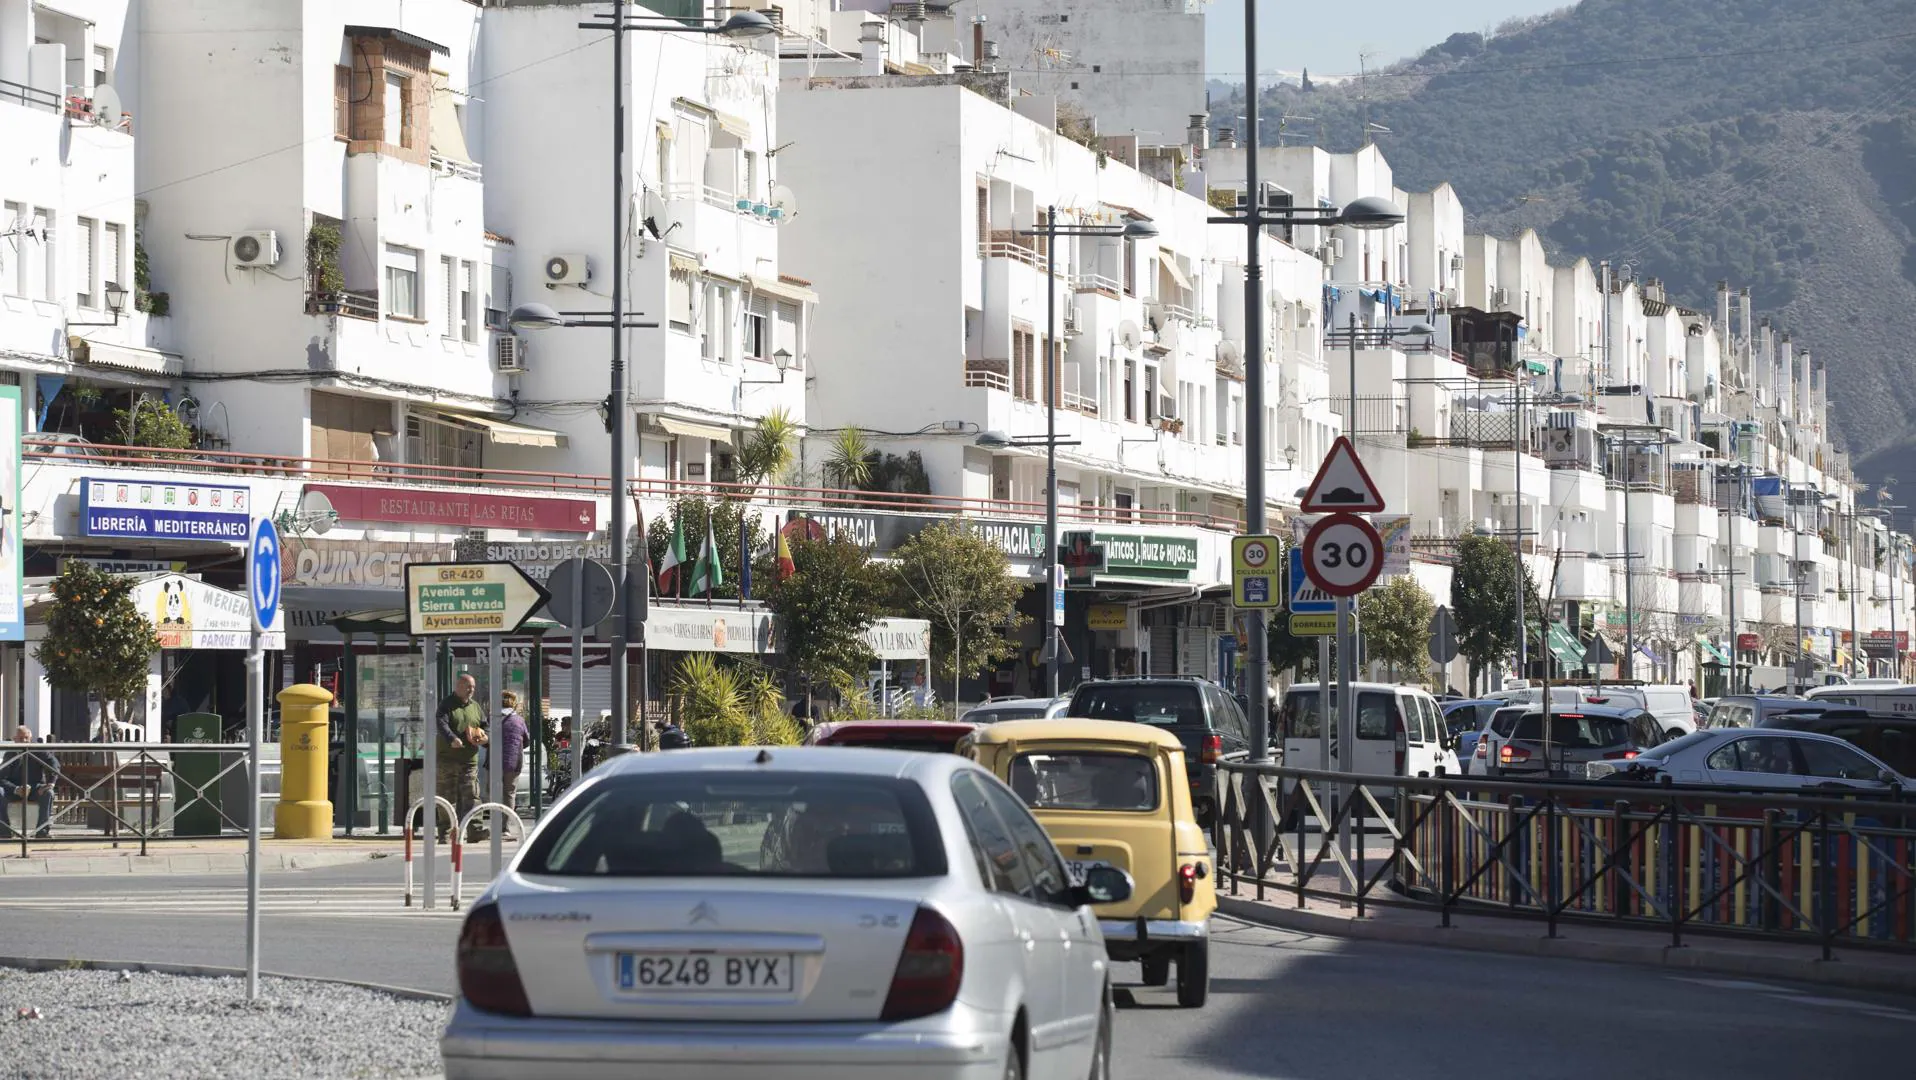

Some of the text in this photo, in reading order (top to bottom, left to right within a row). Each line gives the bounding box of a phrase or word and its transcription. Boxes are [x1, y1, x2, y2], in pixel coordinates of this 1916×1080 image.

[381, 499, 535, 523] RESTAURANTE LAS REJAS
[90, 516, 247, 536] LIBRERÍA MEDITERRÁNEO
[487, 544, 633, 561] SURTIDO DE CARS
[1142, 543, 1159, 560] RUIZ
[1167, 544, 1187, 566] HIJOS
[1248, 550, 1264, 559] 30
[1321, 542, 1367, 568] 30
[440, 570, 483, 580] GR-420
[421, 586, 486, 598] Avenida de
[422, 599, 504, 611] Sierra Nevada
[425, 615, 501, 628] Ayuntamiento
[475, 647, 532, 664] RJAS
[638, 957, 780, 986] 6248 BYX
